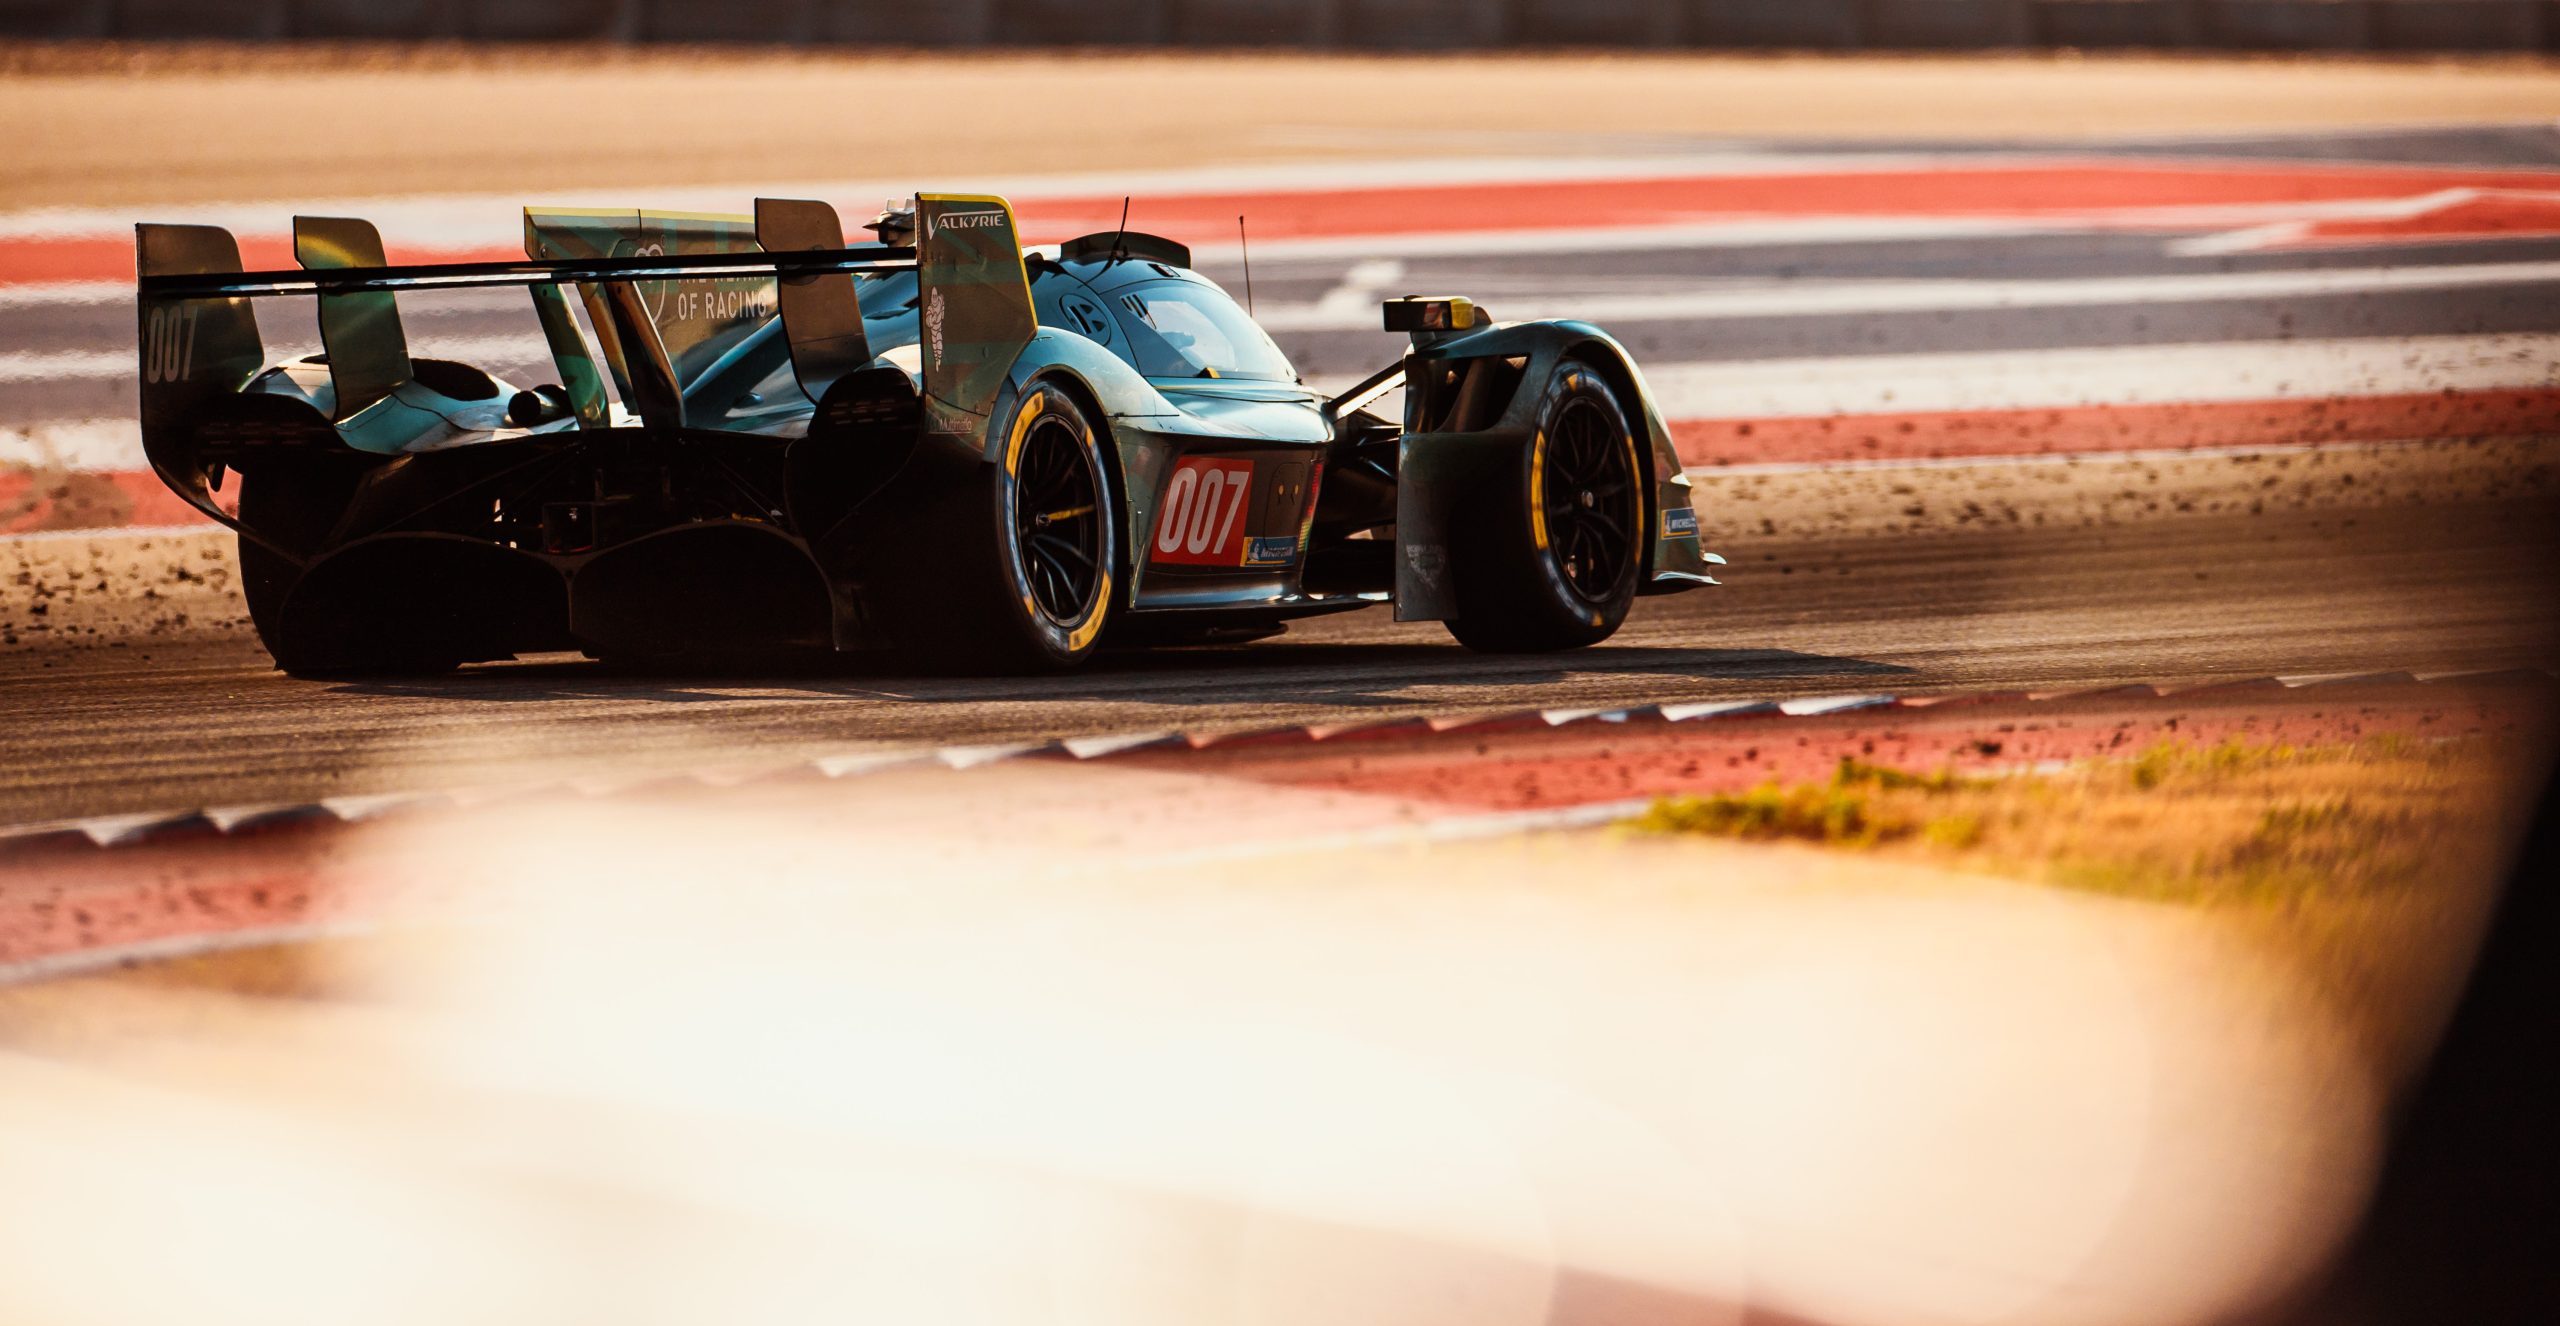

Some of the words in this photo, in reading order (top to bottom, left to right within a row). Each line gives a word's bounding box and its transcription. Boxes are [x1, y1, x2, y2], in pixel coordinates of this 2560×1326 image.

[927, 209, 1005, 240] VALKYRIE
[678, 292, 698, 321] OF
[705, 290, 767, 319] RACING
[148, 305, 198, 384] 007
[1158, 467, 1250, 555] 007
